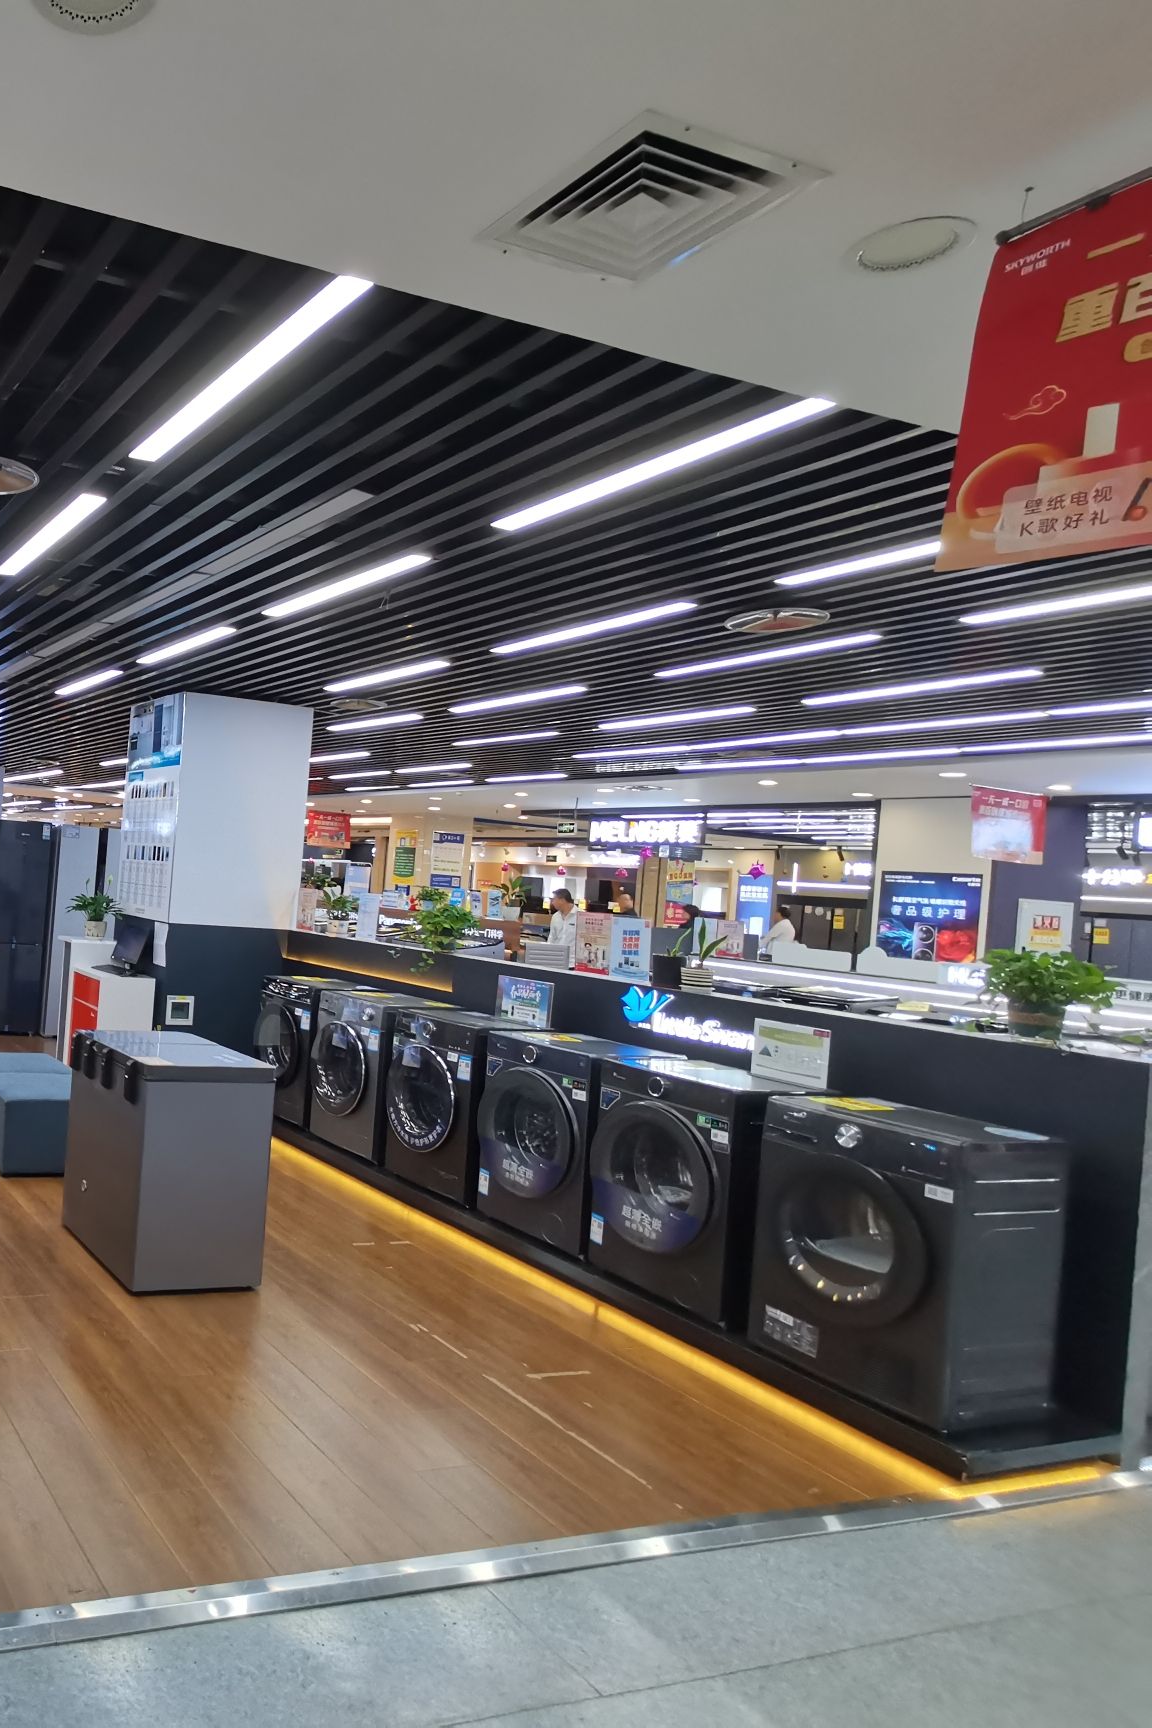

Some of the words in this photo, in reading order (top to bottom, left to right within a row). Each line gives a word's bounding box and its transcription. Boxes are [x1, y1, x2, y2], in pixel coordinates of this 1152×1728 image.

[1004, 238, 1071, 273] SKYWORTH
[1024, 485, 1113, 516] 壁纸电视
[1019, 510, 1111, 538] K歌好礼
[652, 1011, 704, 1044] Little
[700, 1019, 754, 1051] Swan
